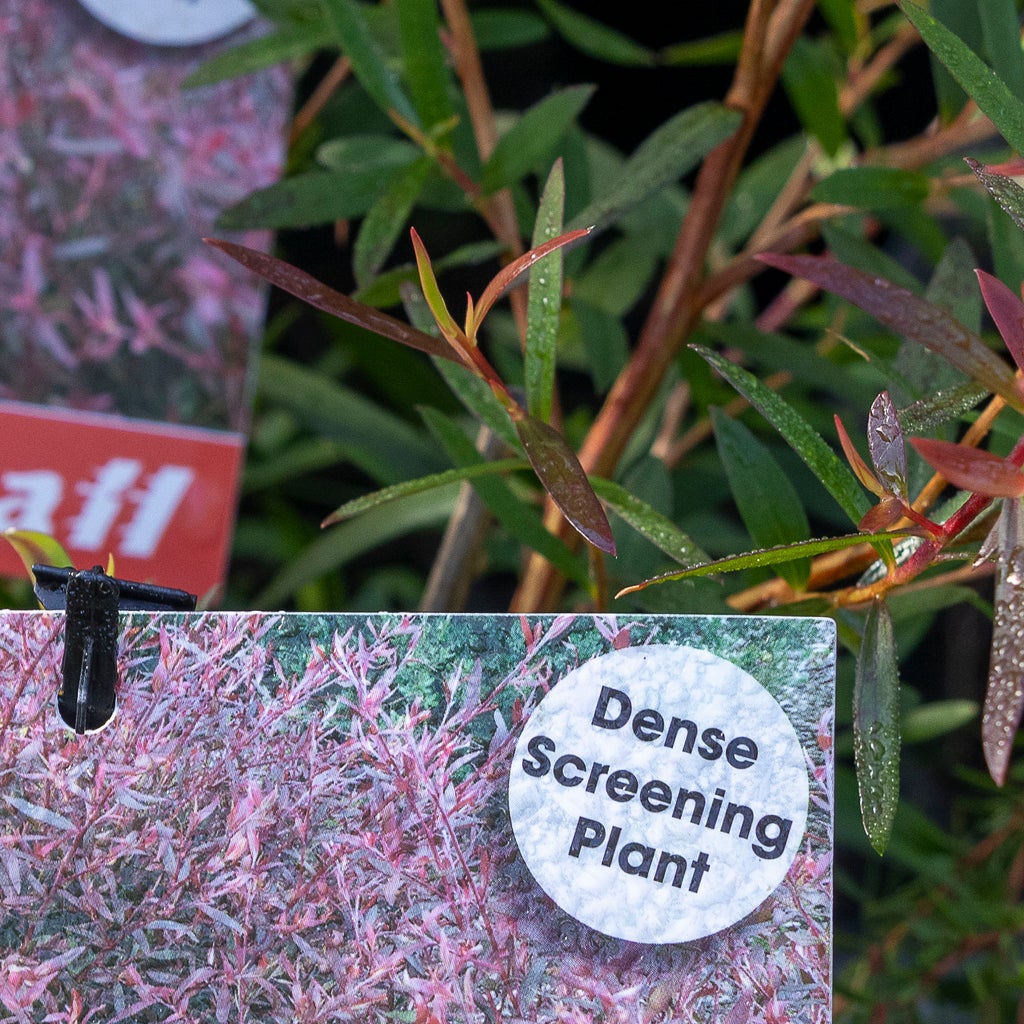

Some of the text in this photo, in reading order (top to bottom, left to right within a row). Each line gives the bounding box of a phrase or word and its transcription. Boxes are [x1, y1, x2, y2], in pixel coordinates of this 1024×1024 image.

[590, 685, 759, 770] Dense
[521, 735, 794, 860] Screening
[567, 815, 711, 893] Plant
